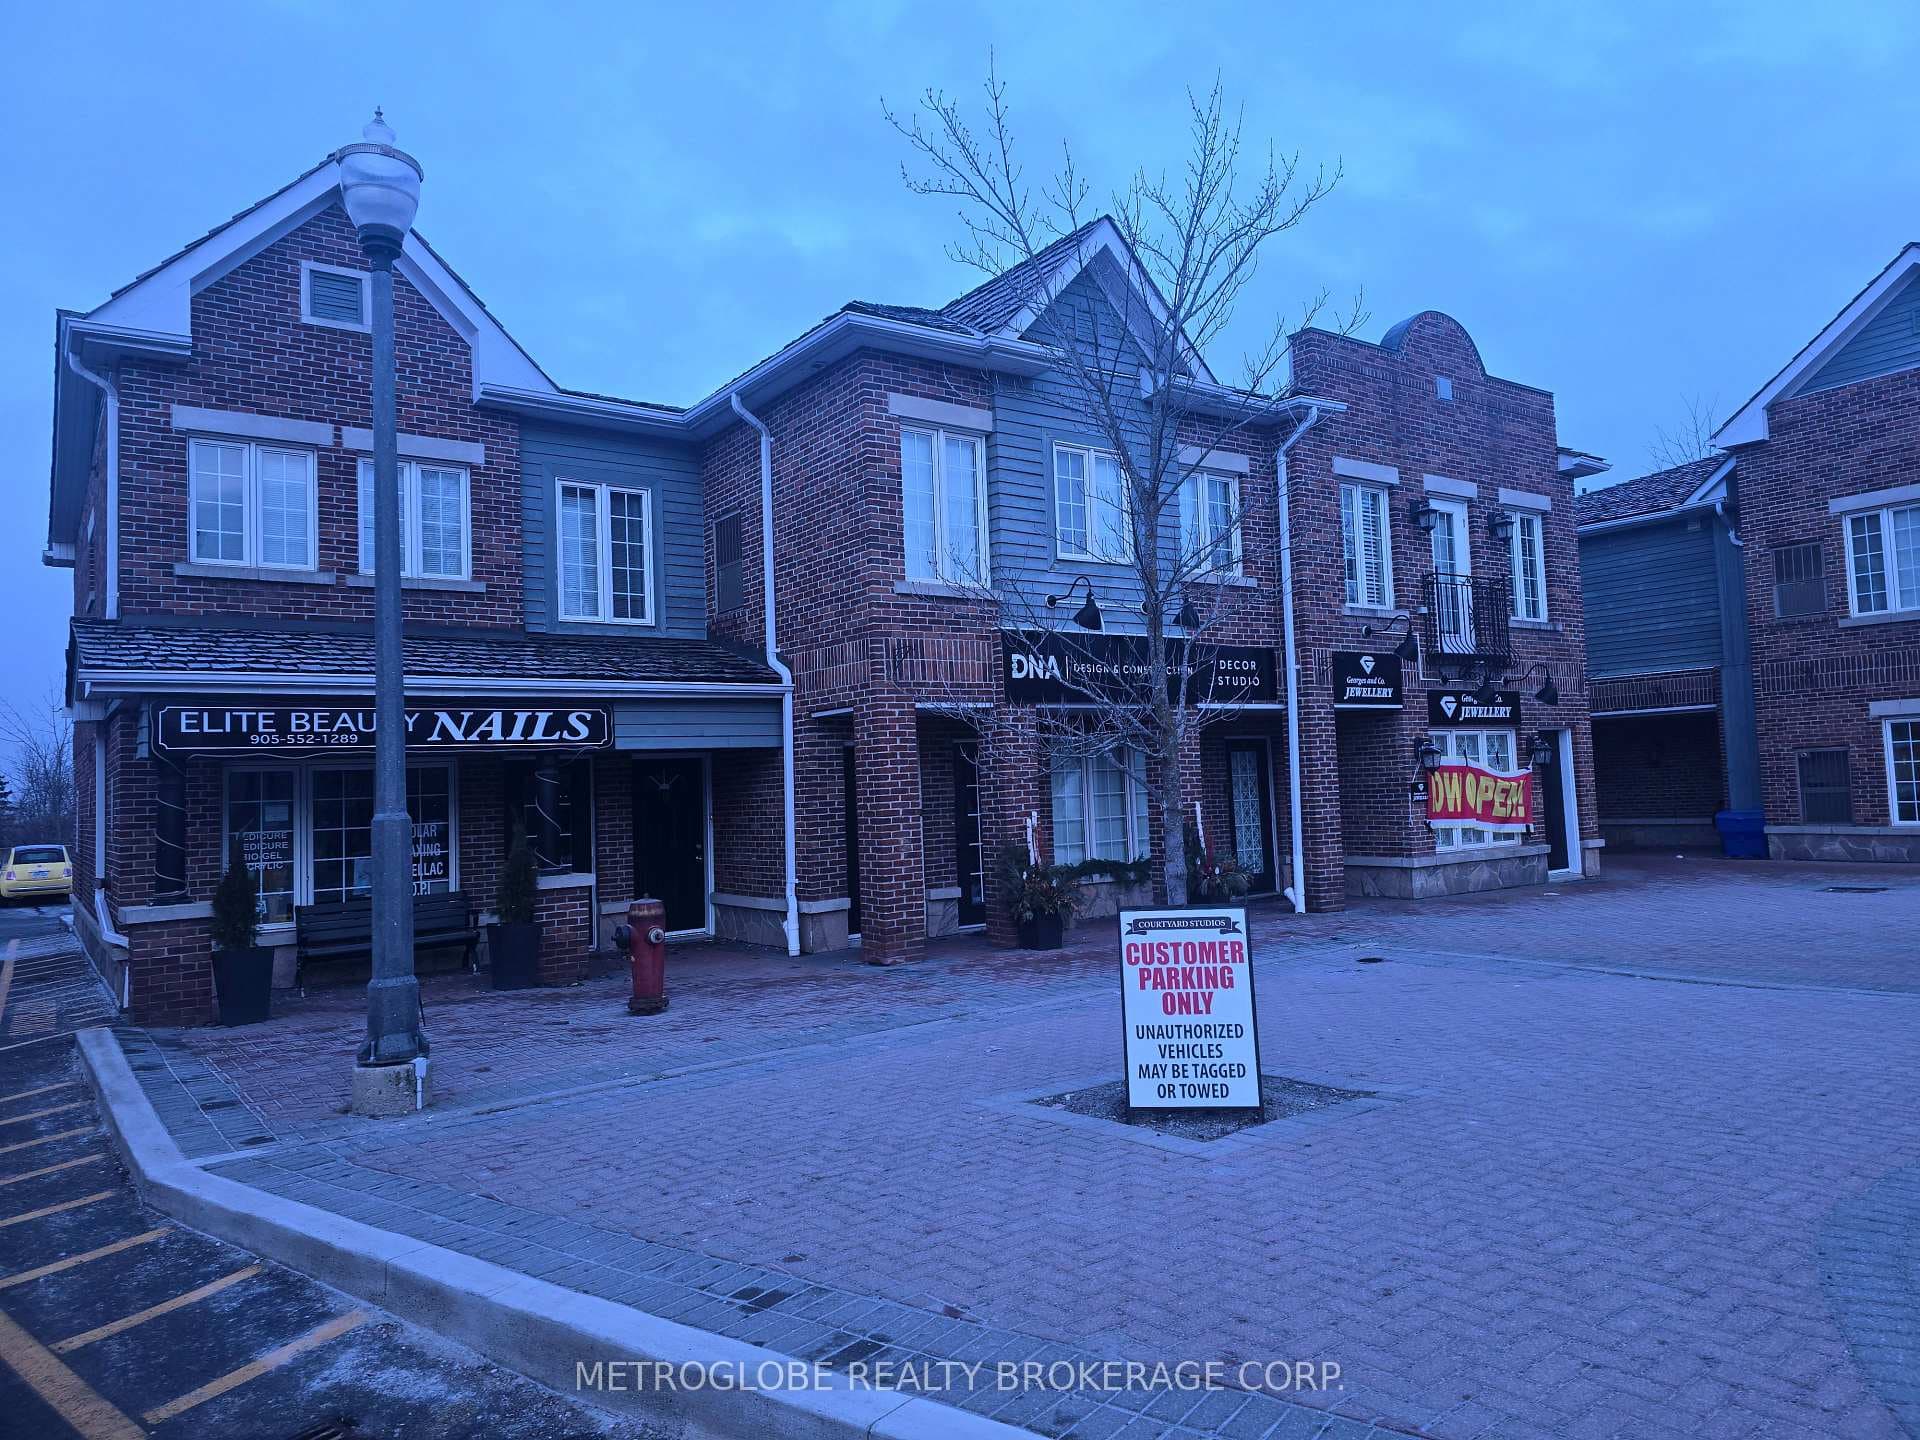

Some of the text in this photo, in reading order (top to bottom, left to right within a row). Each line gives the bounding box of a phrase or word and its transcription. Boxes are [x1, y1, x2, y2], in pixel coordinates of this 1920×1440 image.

[1011, 653, 1061, 679] DNA
[1073, 662, 1109, 674] DESIGN
[1219, 660, 1257, 671] DECOR
[1217, 676, 1260, 687] STUDIO
[1346, 676, 1386, 686] Georges and Co.
[1344, 687, 1394, 700] JEWELLERY
[1459, 706, 1513, 721] JEWELLERY
[180, 711, 592, 741] ELITE BEAUY NAILS
[249, 734, 359, 745] 905-552-1289
[1431, 771, 1462, 813] OW
[236, 832, 288, 841] EDICURE
[411, 824, 437, 838] OLAR
[243, 842, 289, 851] EDICURE
[246, 862, 284, 871] CRYLIC
[412, 862, 444, 877] ELLAC
[1126, 941, 1245, 966] CUSTOMER
[1138, 966, 1234, 990] PARKING
[1162, 991, 1214, 1015] ONLY
[1136, 1024, 1244, 1039] UNAUTHORIZED
[1158, 1044, 1223, 1059] VEHICLES
[1138, 1063, 1246, 1079] MAY BE TAGGED
[1157, 1084, 1229, 1099] OR TOWED
